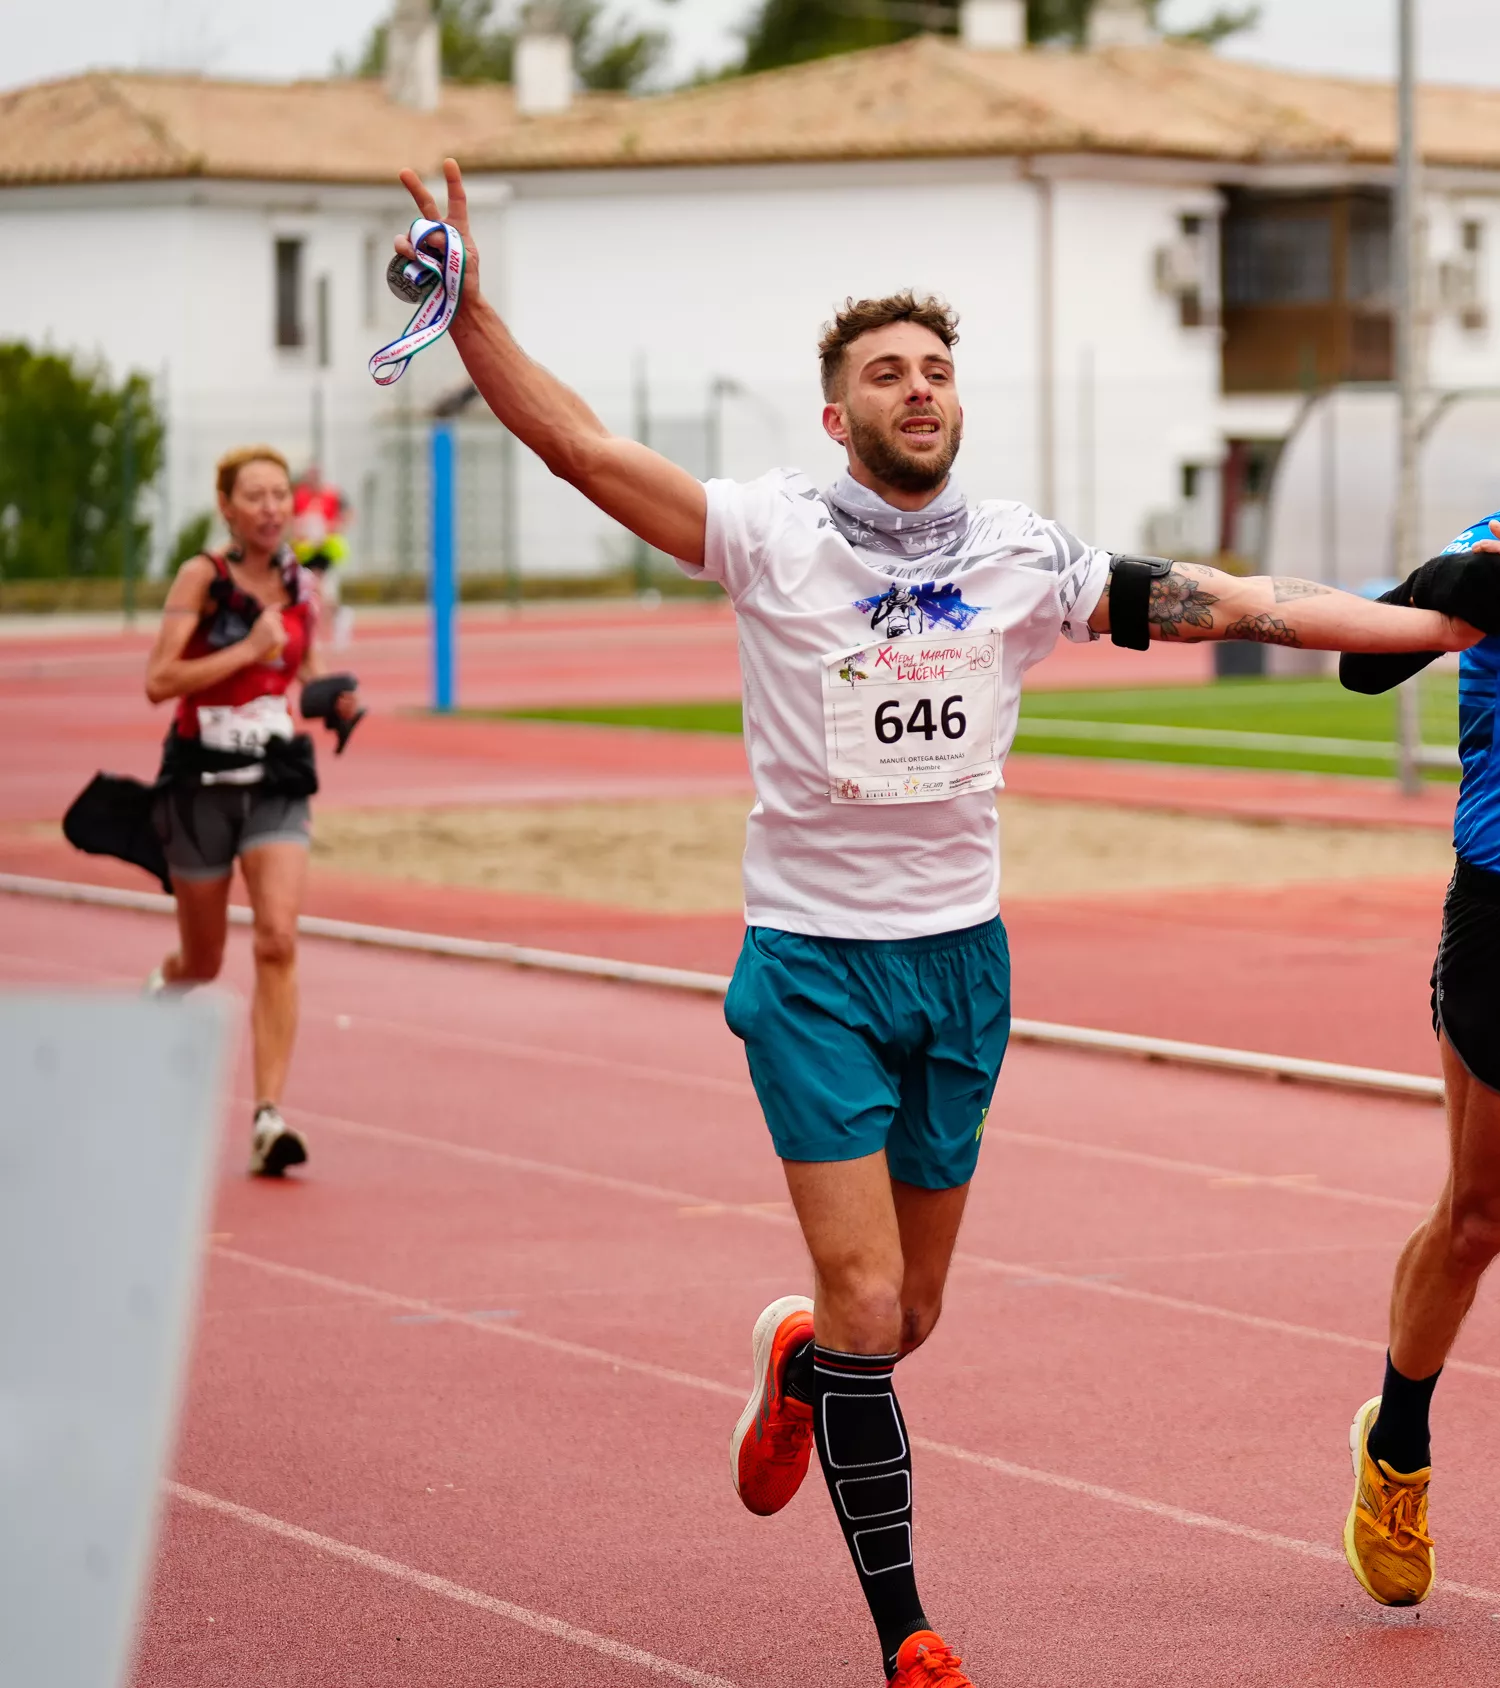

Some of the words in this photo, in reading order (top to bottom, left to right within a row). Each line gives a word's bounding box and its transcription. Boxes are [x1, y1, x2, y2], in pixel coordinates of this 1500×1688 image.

[449, 249, 460, 274] 2024
[921, 647, 963, 661] MARATÓN
[897, 664, 953, 681] LUCENA
[874, 694, 967, 744] 646
[879, 756, 907, 764] MANUEL
[908, 755, 934, 763] ORTEGA
[934, 753, 965, 761] BALTANÁS
